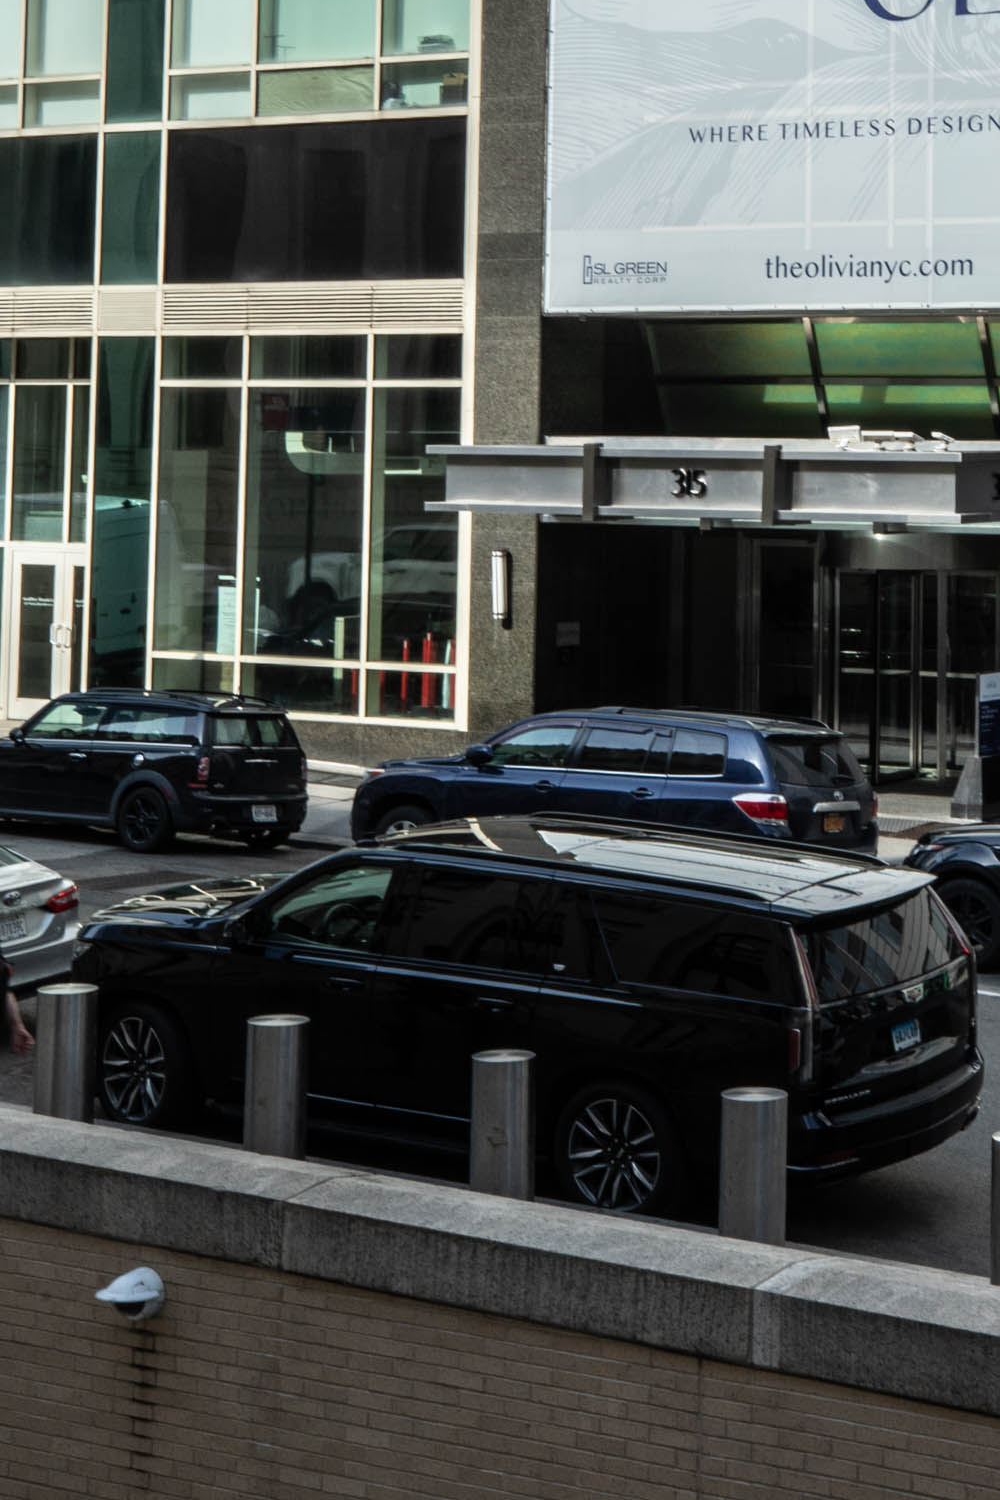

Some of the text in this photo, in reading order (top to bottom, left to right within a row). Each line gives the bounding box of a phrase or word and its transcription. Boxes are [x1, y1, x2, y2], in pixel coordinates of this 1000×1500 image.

[688, 123, 769, 143] WHERE
[778, 117, 896, 141] TIMELESS
[593, 261, 668, 276] SL GREEN
[765, 254, 974, 284] theolivianyc.com
[671, 468, 708, 499] 315
